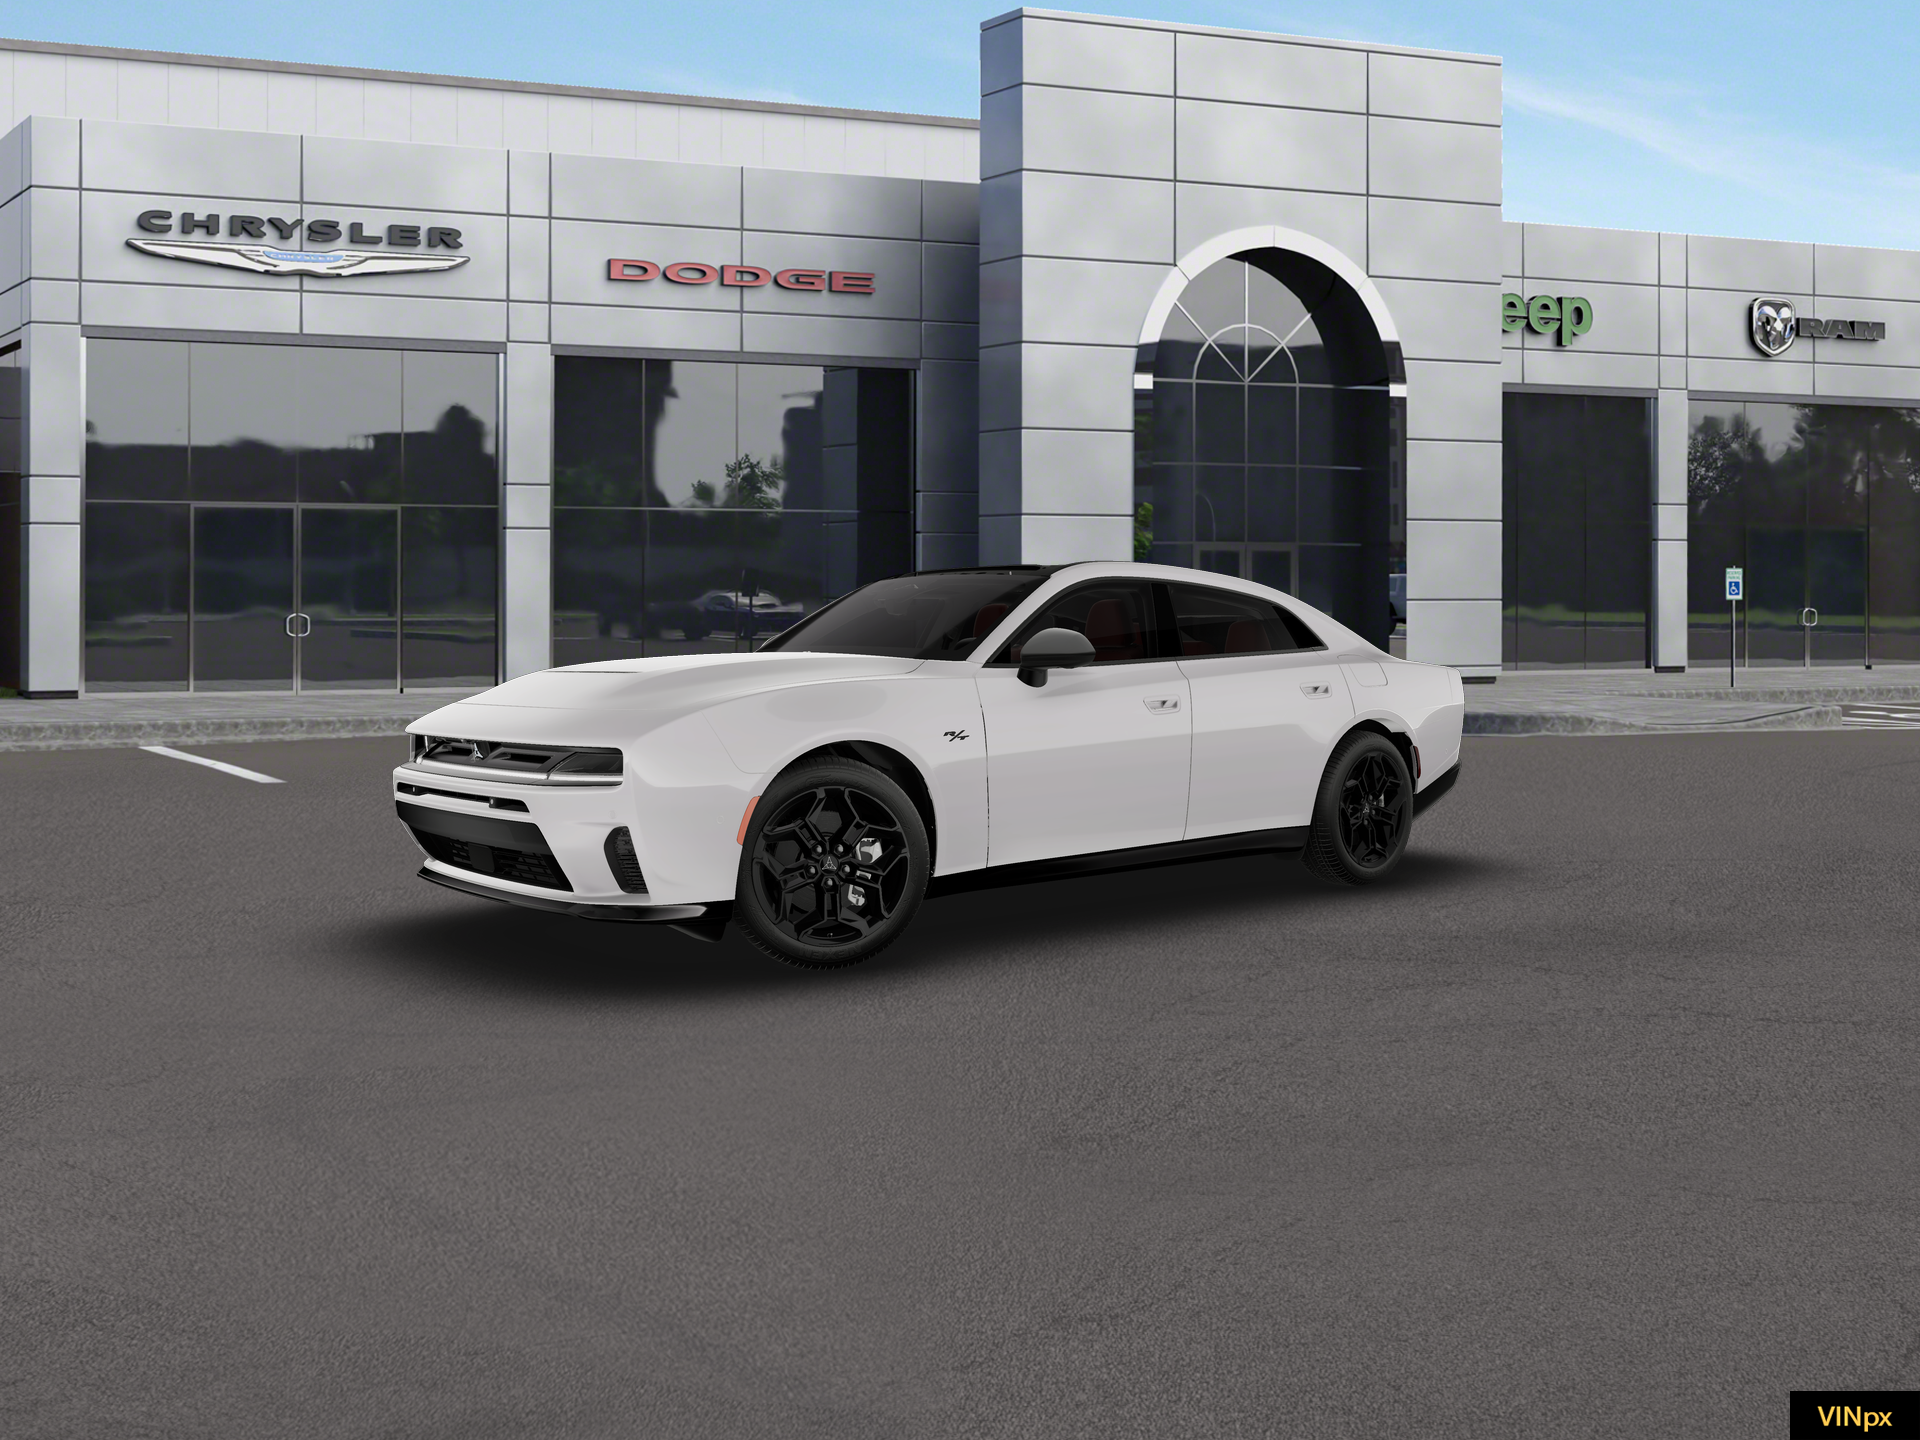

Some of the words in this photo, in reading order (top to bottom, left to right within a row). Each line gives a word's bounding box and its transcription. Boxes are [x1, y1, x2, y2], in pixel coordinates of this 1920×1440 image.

[137, 209, 464, 249] CHRYSLER
[270, 253, 334, 261] CHRYSLER
[607, 258, 876, 293] DODGE
[1502, 292, 1593, 347] eep
[1795, 317, 1886, 341] RAM
[943, 729, 970, 742] R/T
